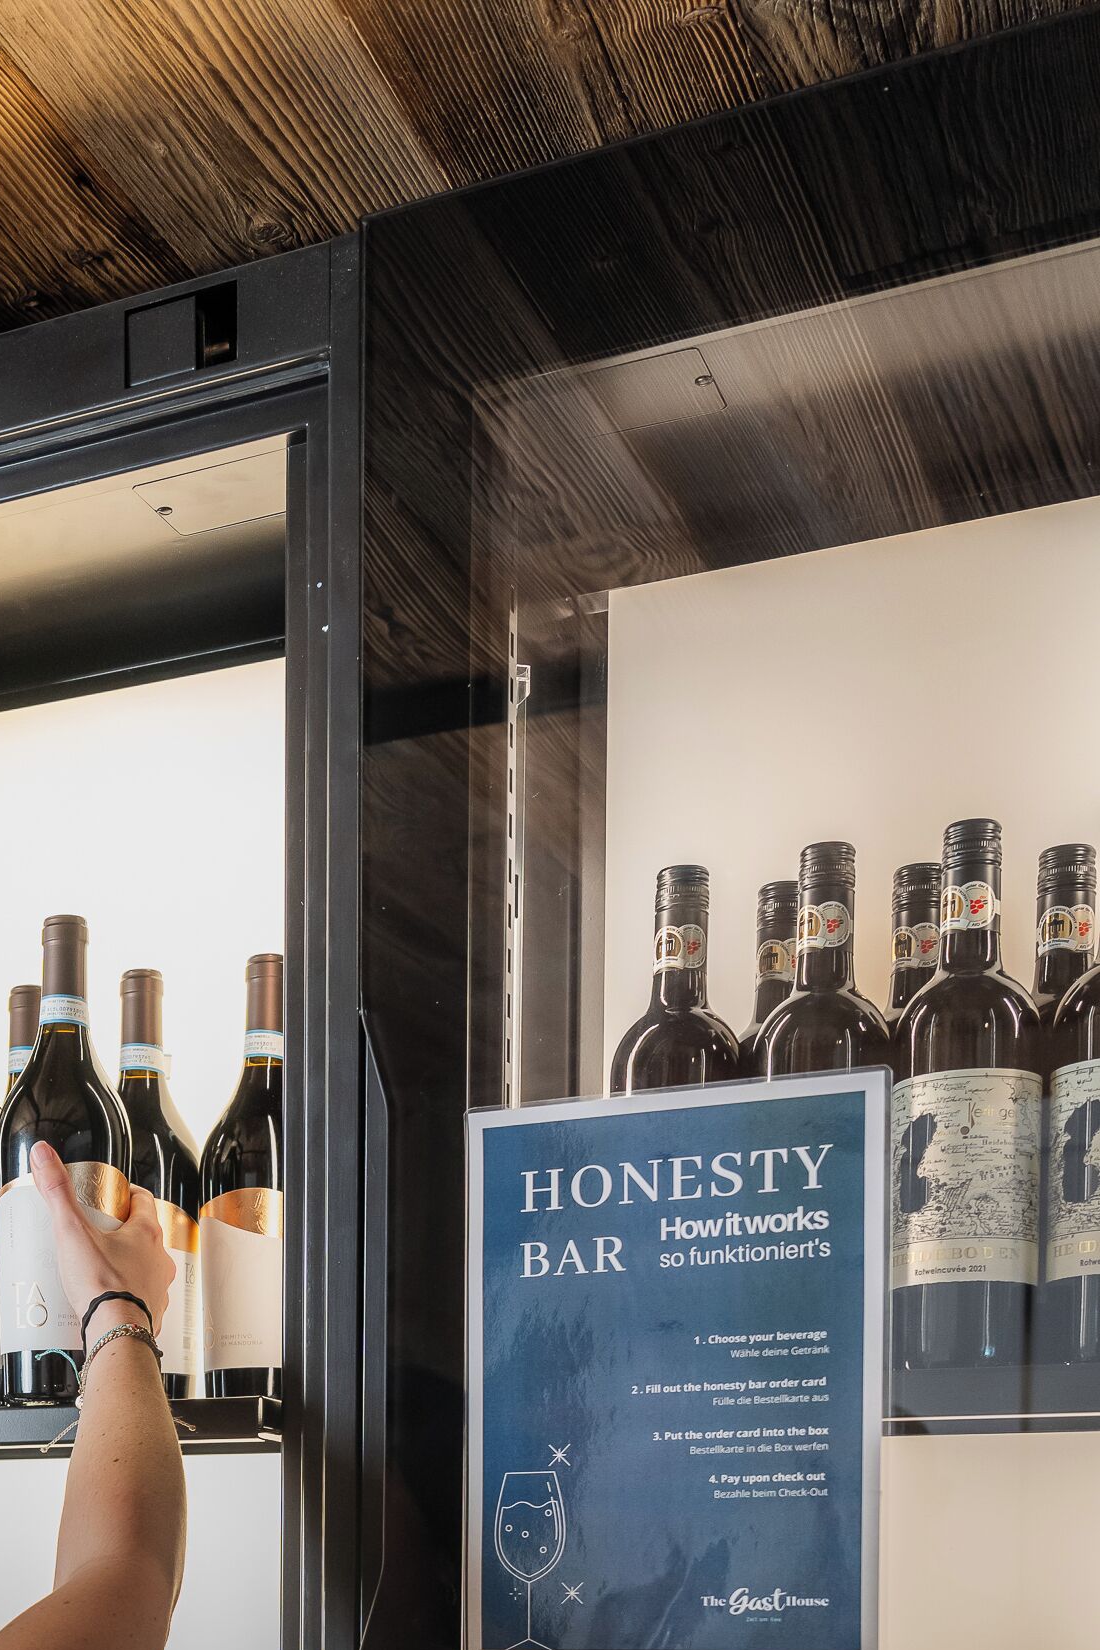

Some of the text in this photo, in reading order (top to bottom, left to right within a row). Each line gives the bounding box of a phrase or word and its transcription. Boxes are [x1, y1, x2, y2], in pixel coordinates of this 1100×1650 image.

[520, 1143, 834, 1213] HONESTY
[520, 1236, 627, 1278] BAR
[659, 1237, 831, 1268] so funktioniert's
[914, 1264, 987, 1276] Rotweincuvée 2021
[708, 1334, 747, 1344] Choose
[748, 1332, 774, 1344] your
[776, 1330, 828, 1342] beverage
[730, 1345, 831, 1358] Wähle deine Getränk
[645, 1383, 661, 1394] Fill
[663, 1383, 681, 1393] out
[683, 1382, 701, 1392] the
[703, 1380, 747, 1393] honesty
[749, 1380, 768, 1389] bar
[769, 1378, 800, 1388] order
[801, 1376, 827, 1387] card
[712, 1393, 830, 1406] Fülle die Bestellkarte aus
[652, 1425, 829, 1441] 3. Put the order card into the box
[689, 1441, 829, 1455] Bestellkarte in die Box werfen
[709, 1471, 826, 1485] 4. Pay upon check out
[713, 1487, 828, 1499] Bezahle beim Check-Out
[700, 1587, 830, 1615] The Gast House
